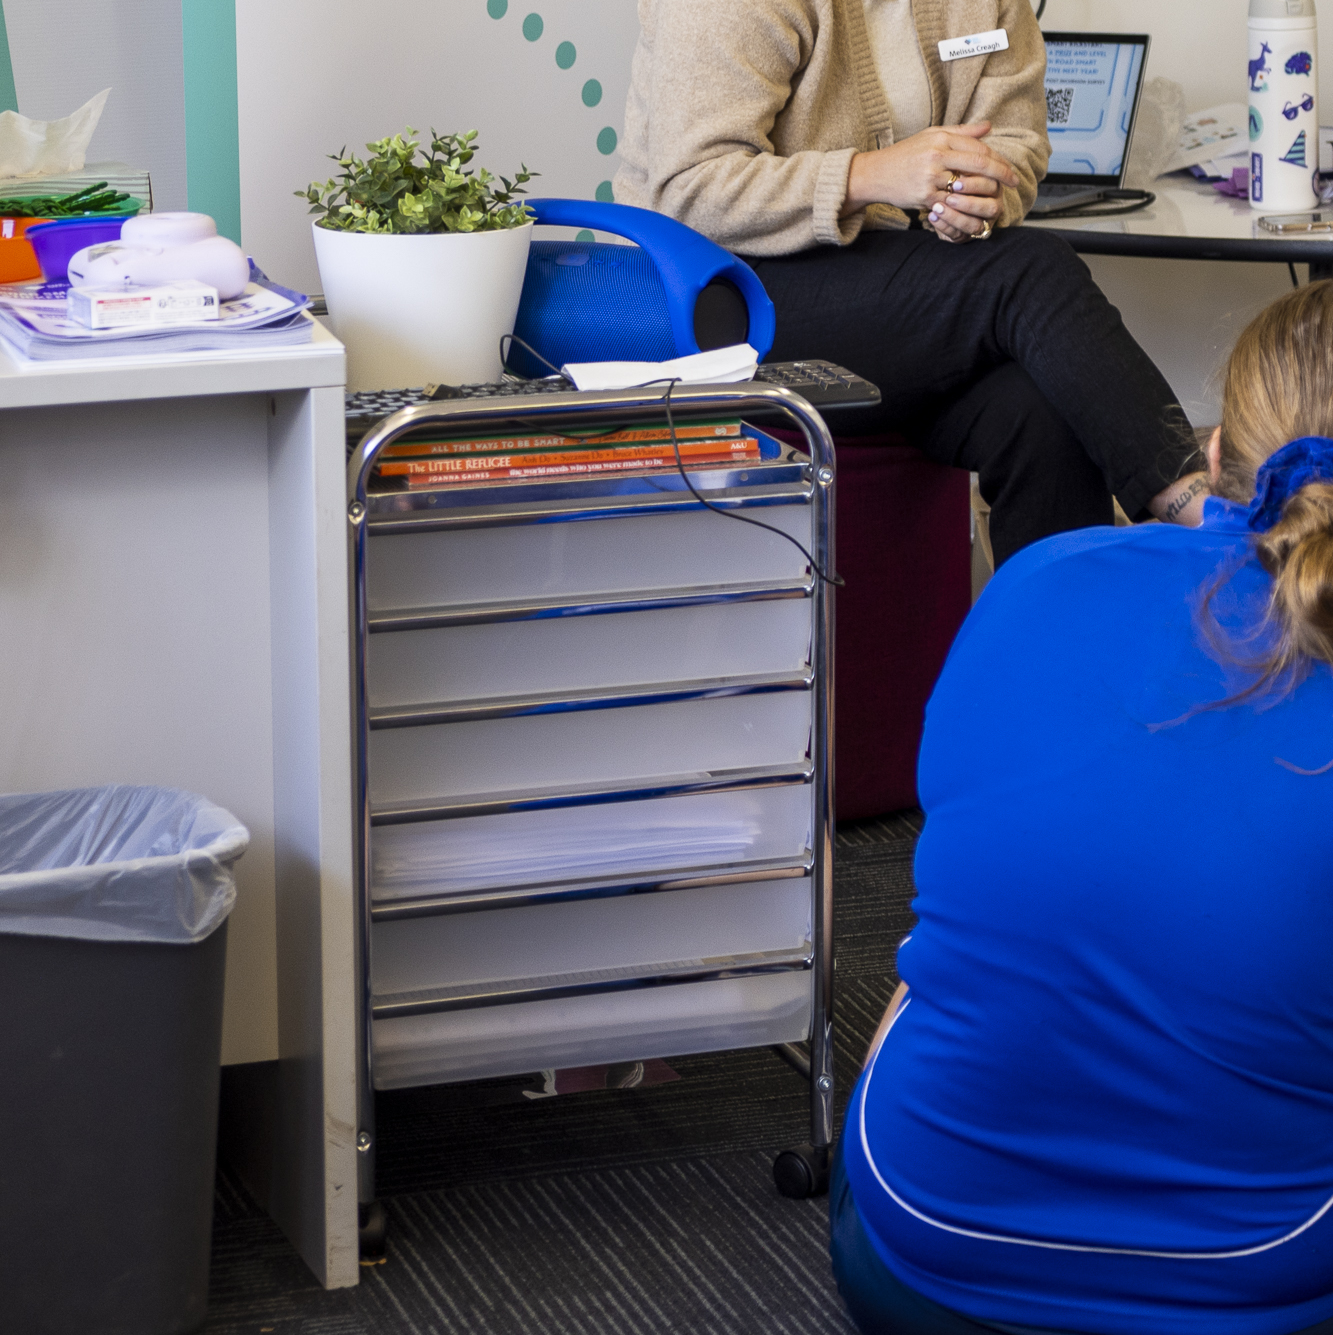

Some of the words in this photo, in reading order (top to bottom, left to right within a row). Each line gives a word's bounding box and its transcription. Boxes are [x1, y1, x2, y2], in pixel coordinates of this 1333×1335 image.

[949, 47, 975, 57] Melissa
[976, 42, 1000, 52] Creagh
[453, 444, 471, 452] THE
[475, 442, 499, 451] WAYS
[501, 441, 514, 449] TO
[517, 440, 530, 448] BE
[534, 437, 566, 446] SMART
[730, 442, 747, 450] A&U
[408, 463, 426, 474] The
[428, 461, 462, 473] LITTLE
[465, 458, 512, 470] REFUGEE
[523, 467, 545, 475] world
[588, 464, 602, 472] you
[623, 460, 644, 468] made
[428, 474, 460, 482] JOANNA
[461, 472, 490, 480] GAINES
